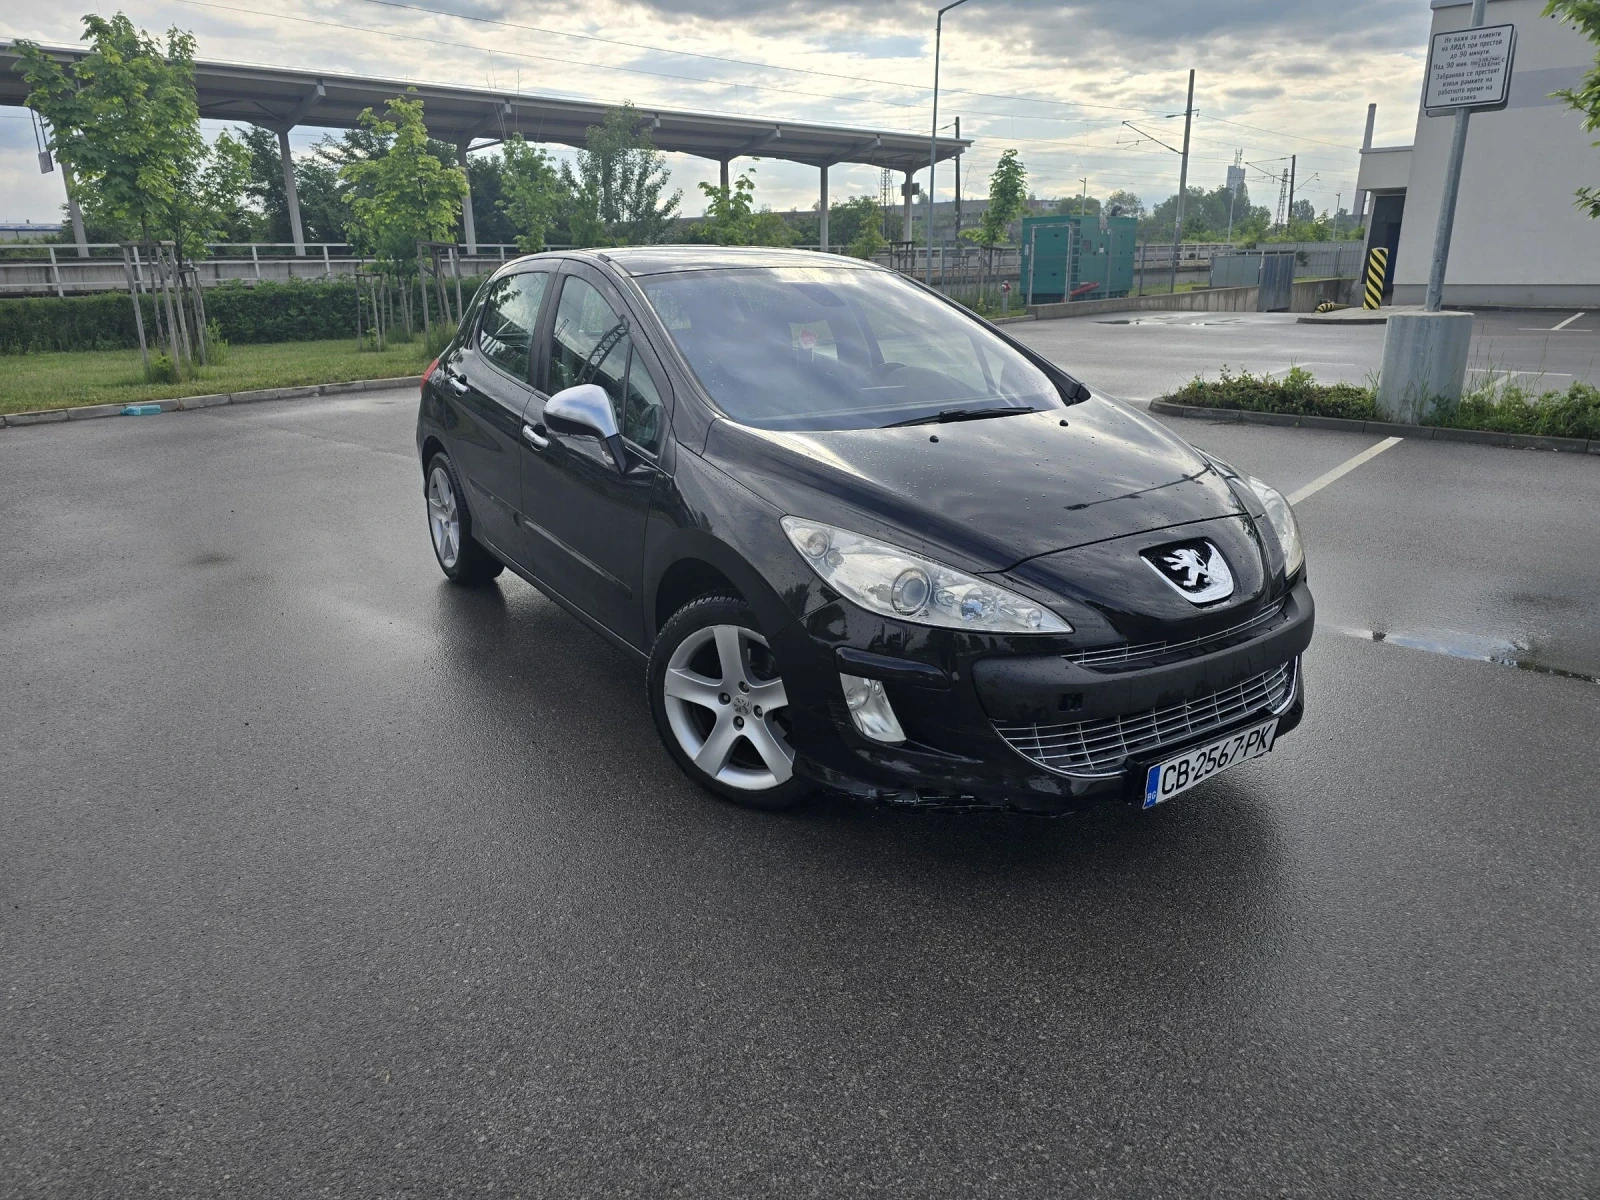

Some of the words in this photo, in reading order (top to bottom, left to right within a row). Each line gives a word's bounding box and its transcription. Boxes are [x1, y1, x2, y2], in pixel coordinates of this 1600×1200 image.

[1480, 40, 1502, 48] престой
[1436, 71, 1464, 80] Забранява
[1460, 78, 1483, 86] рамките
[1438, 88, 1465, 97] работното
[1467, 85, 1484, 94] време
[1147, 790, 1157, 802] BG
